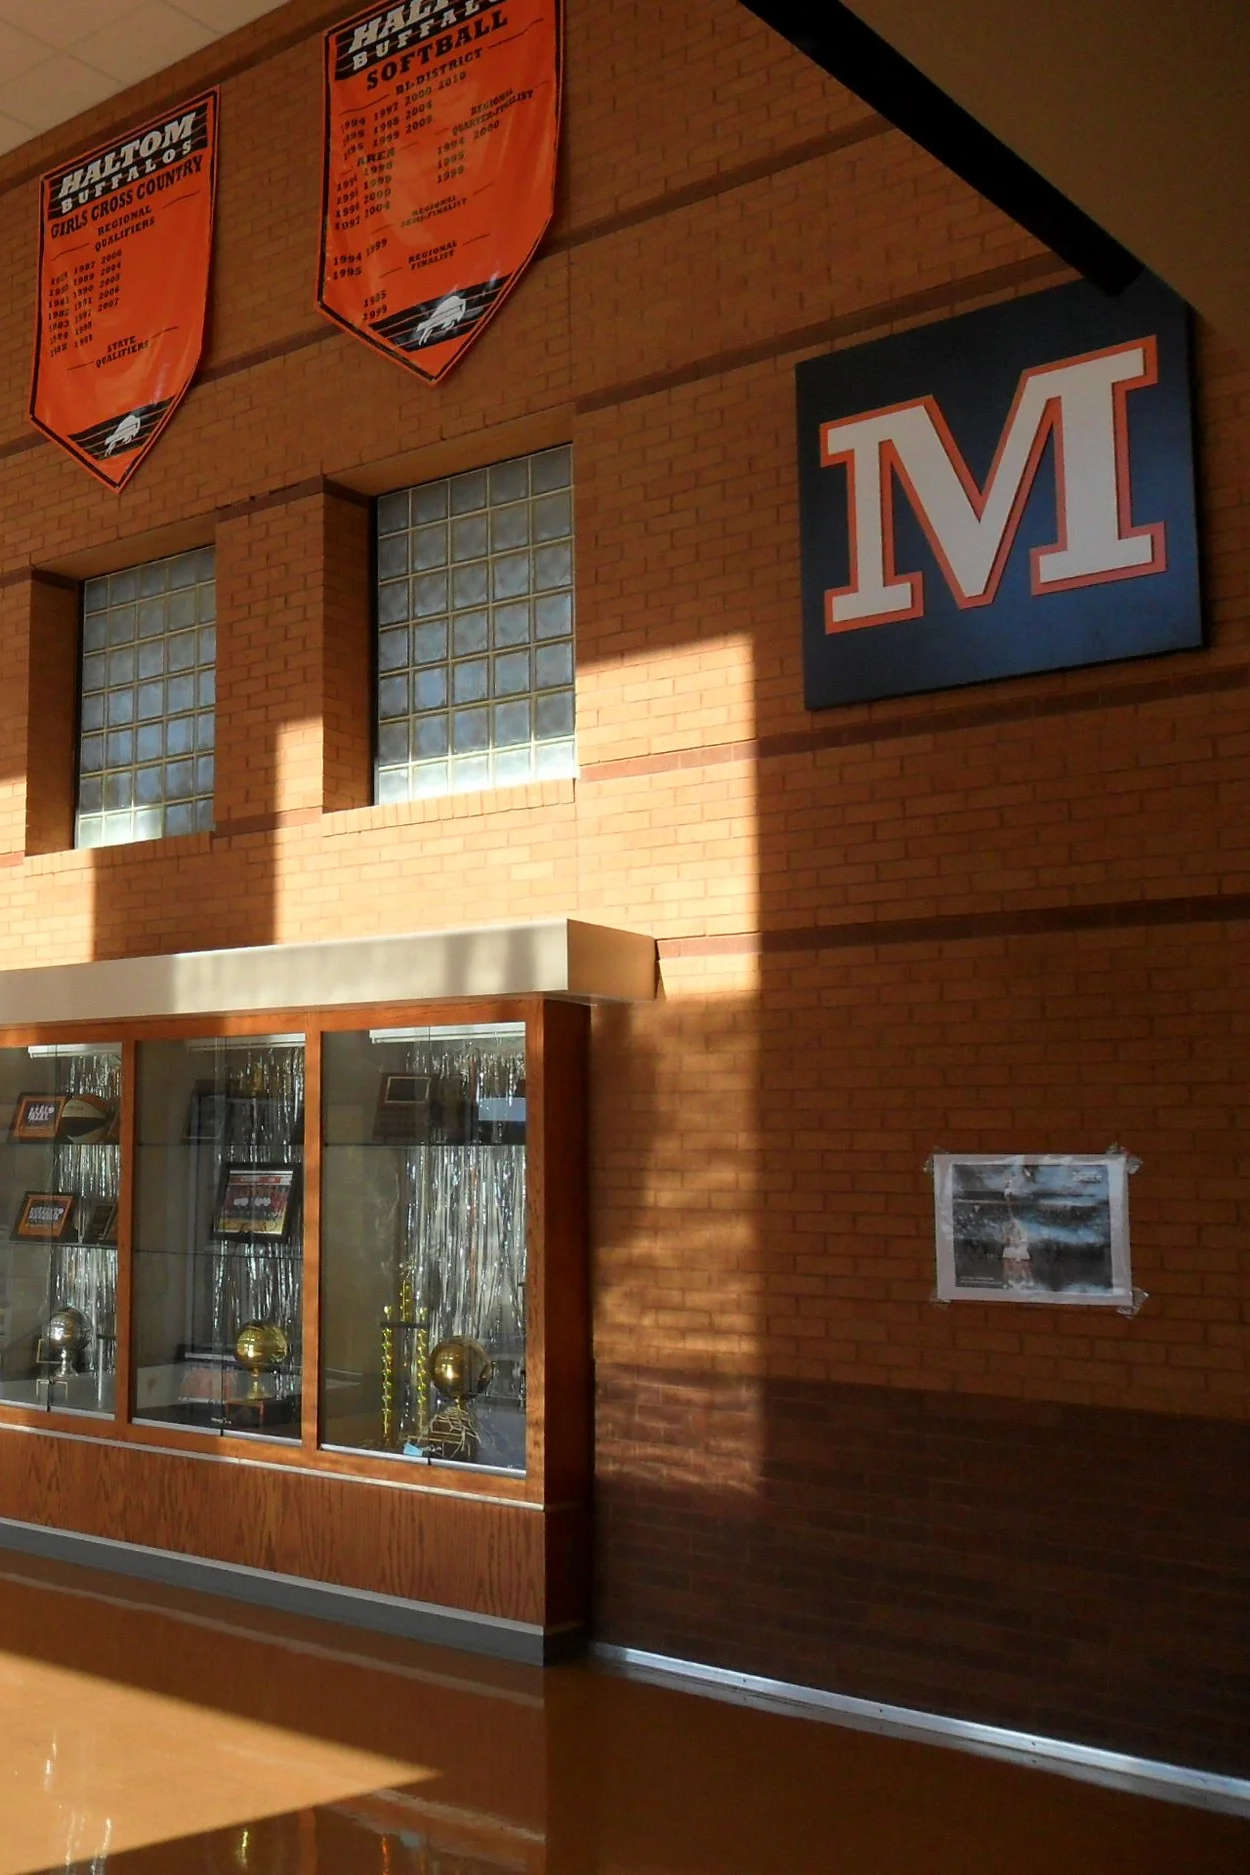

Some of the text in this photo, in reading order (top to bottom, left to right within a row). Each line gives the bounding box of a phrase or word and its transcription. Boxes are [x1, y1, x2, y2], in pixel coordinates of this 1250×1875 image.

[348, 0, 449, 53] HAL
[352, 0, 496, 70] BUFFAL
[366, 10, 508, 91] SOFTBALL
[395, 47, 483, 96] BI-DISTRICT
[58, 112, 196, 199] HALTOM
[61, 140, 193, 214] BUFFALOS
[51, 154, 203, 239] GIRLS CROSS COUNTRY
[97, 205, 152, 236] REGIONAL
[95, 216, 155, 252] QUALIFIERS
[407, 240, 458, 264] REGIONAL
[411, 250, 455, 271] FINALIST
[95, 340, 149, 368] QUALIFIERS
[107, 335, 136, 353] STATE
[819, 334, 1167, 635] M
